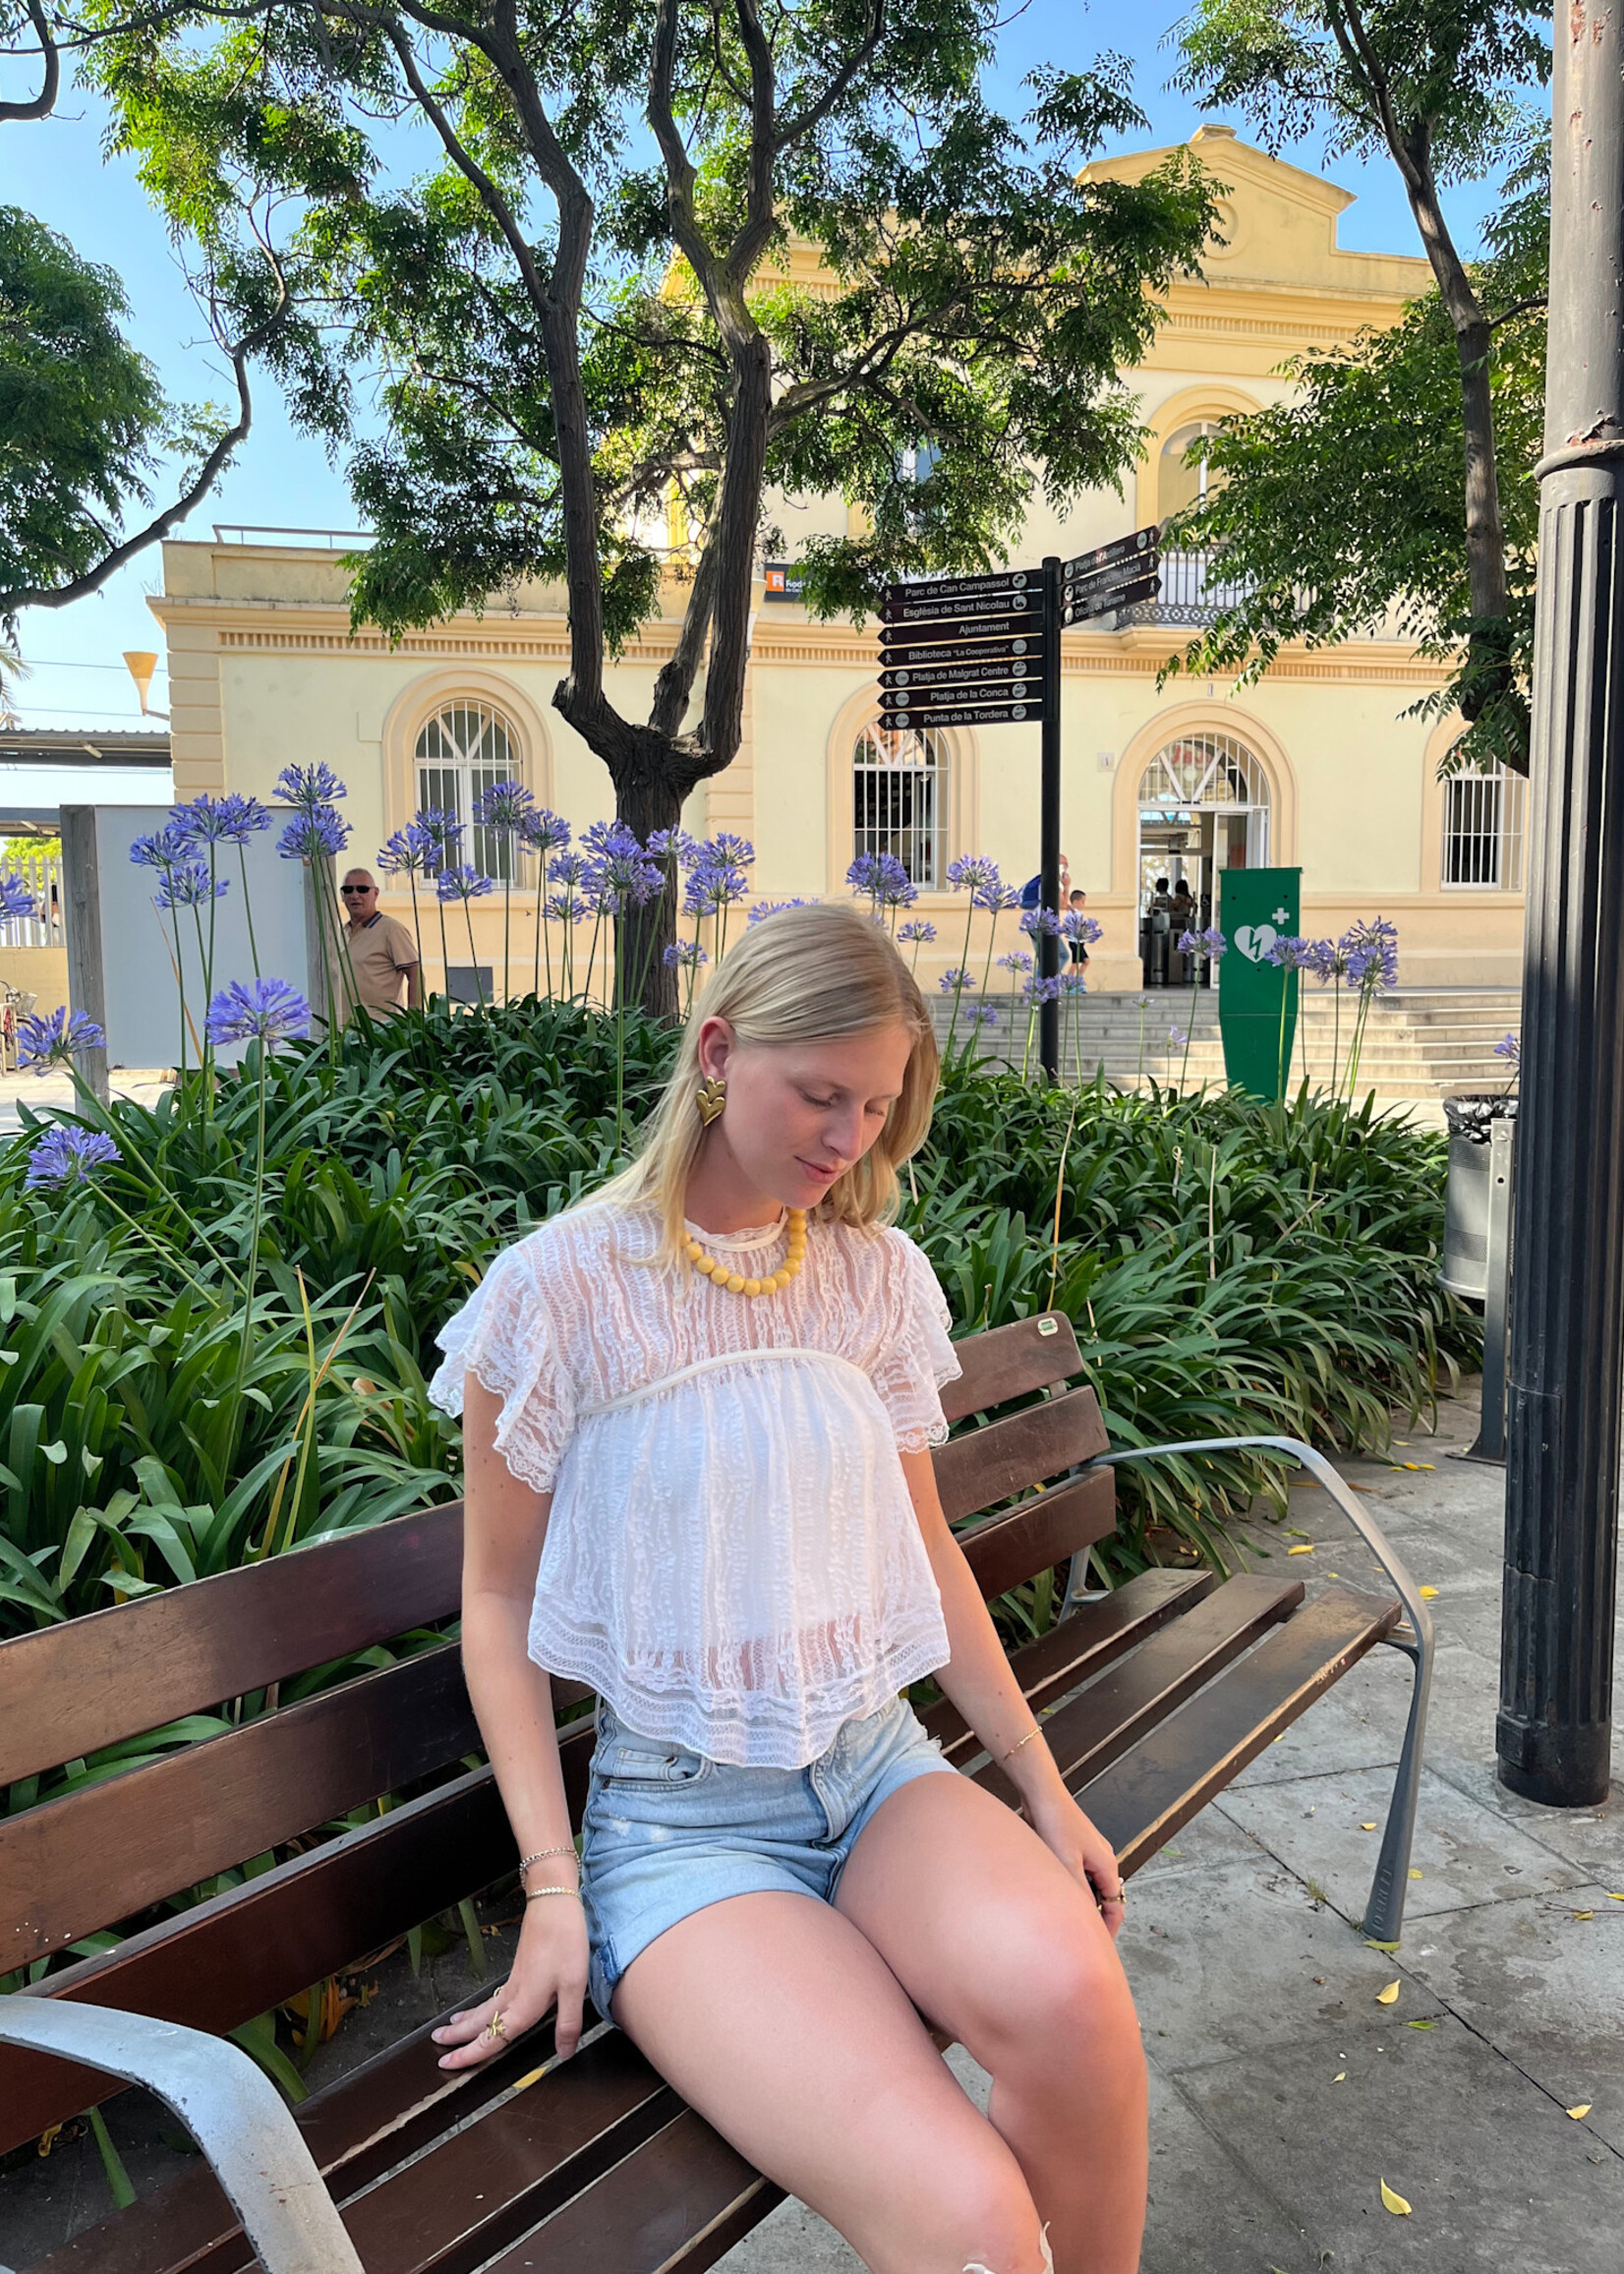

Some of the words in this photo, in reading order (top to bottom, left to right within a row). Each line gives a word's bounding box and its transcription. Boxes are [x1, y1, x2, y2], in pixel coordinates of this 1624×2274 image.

[904, 588, 925, 598] Parc
[926, 586, 939, 595] de
[939, 584, 957, 594] Can
[958, 577, 1010, 592] Campassol
[1074, 583, 1088, 595] Parc
[1088, 580, 1096, 590] de
[941, 605, 954, 613] de
[954, 603, 974, 612] Sant
[975, 601, 1011, 611] Nicolau
[958, 621, 1011, 636] Ajuntament
[908, 649, 952, 661] Biblioteca
[912, 671, 936, 682] Platja
[936, 671, 948, 680] de
[948, 669, 980, 680] Malgrat
[980, 667, 1010, 676] Centre
[930, 691, 956, 702] Platja
[956, 690, 968, 700] de
[969, 689, 978, 699] la
[978, 687, 1010, 698] Conca
[923, 714, 950, 724] Punta
[951, 713, 962, 722] de
[963, 712, 972, 721] la
[973, 709, 1010, 720] Tordera
